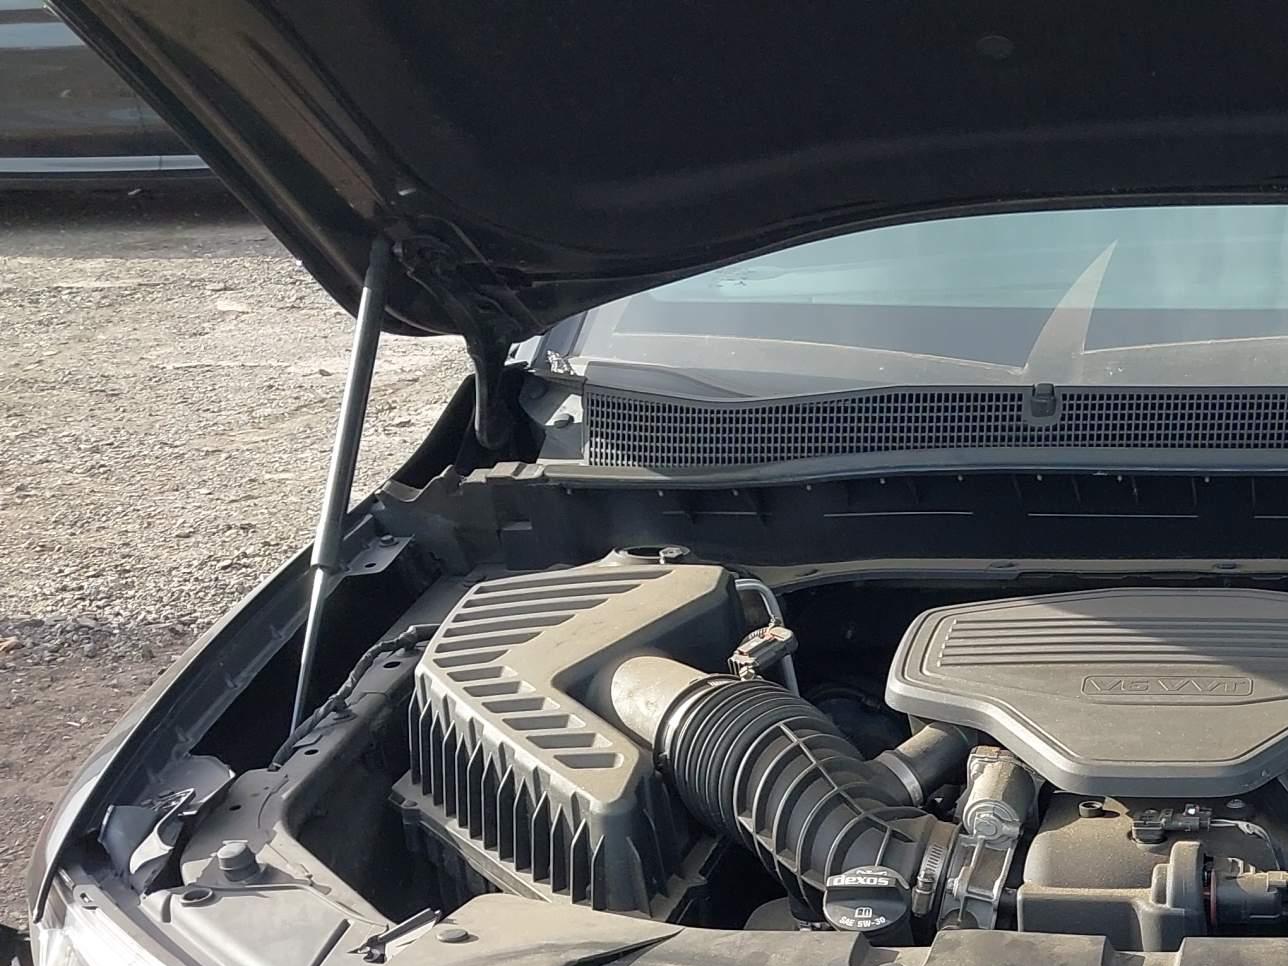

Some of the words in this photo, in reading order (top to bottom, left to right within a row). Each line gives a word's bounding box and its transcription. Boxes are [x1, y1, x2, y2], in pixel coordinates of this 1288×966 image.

[832, 874, 889, 886] dexos
[840, 915, 855, 927] SAE
[857, 916, 886, 928] 5W-30
